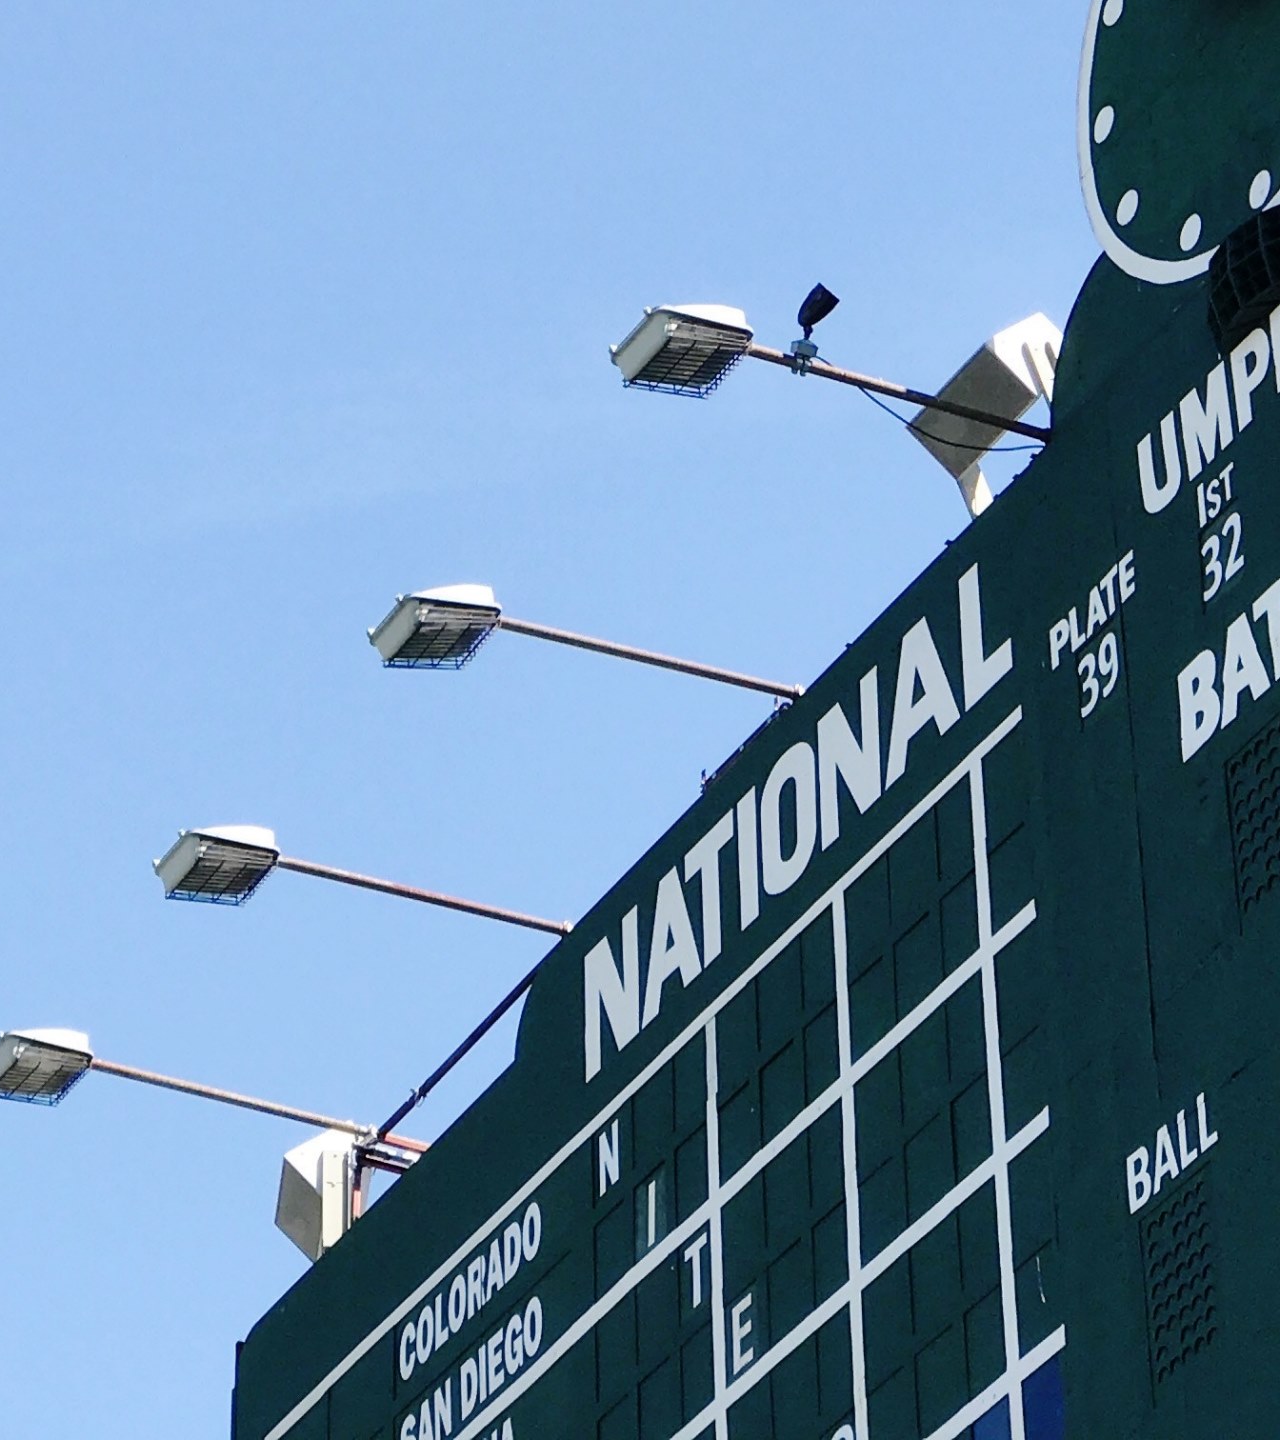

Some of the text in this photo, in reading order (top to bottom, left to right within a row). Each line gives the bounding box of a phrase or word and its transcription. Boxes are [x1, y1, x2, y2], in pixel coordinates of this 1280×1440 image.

[1050, 550, 1135, 670] PLATE
[1202, 513, 1244, 601] 32
[1078, 633, 1118, 717] 39
[585, 563, 1012, 1083] NATIONAL
[1127, 1093, 1218, 1214] BALL
[400, 1203, 541, 1380] COLORADO
[461, 1297, 542, 1420] DIEGO
